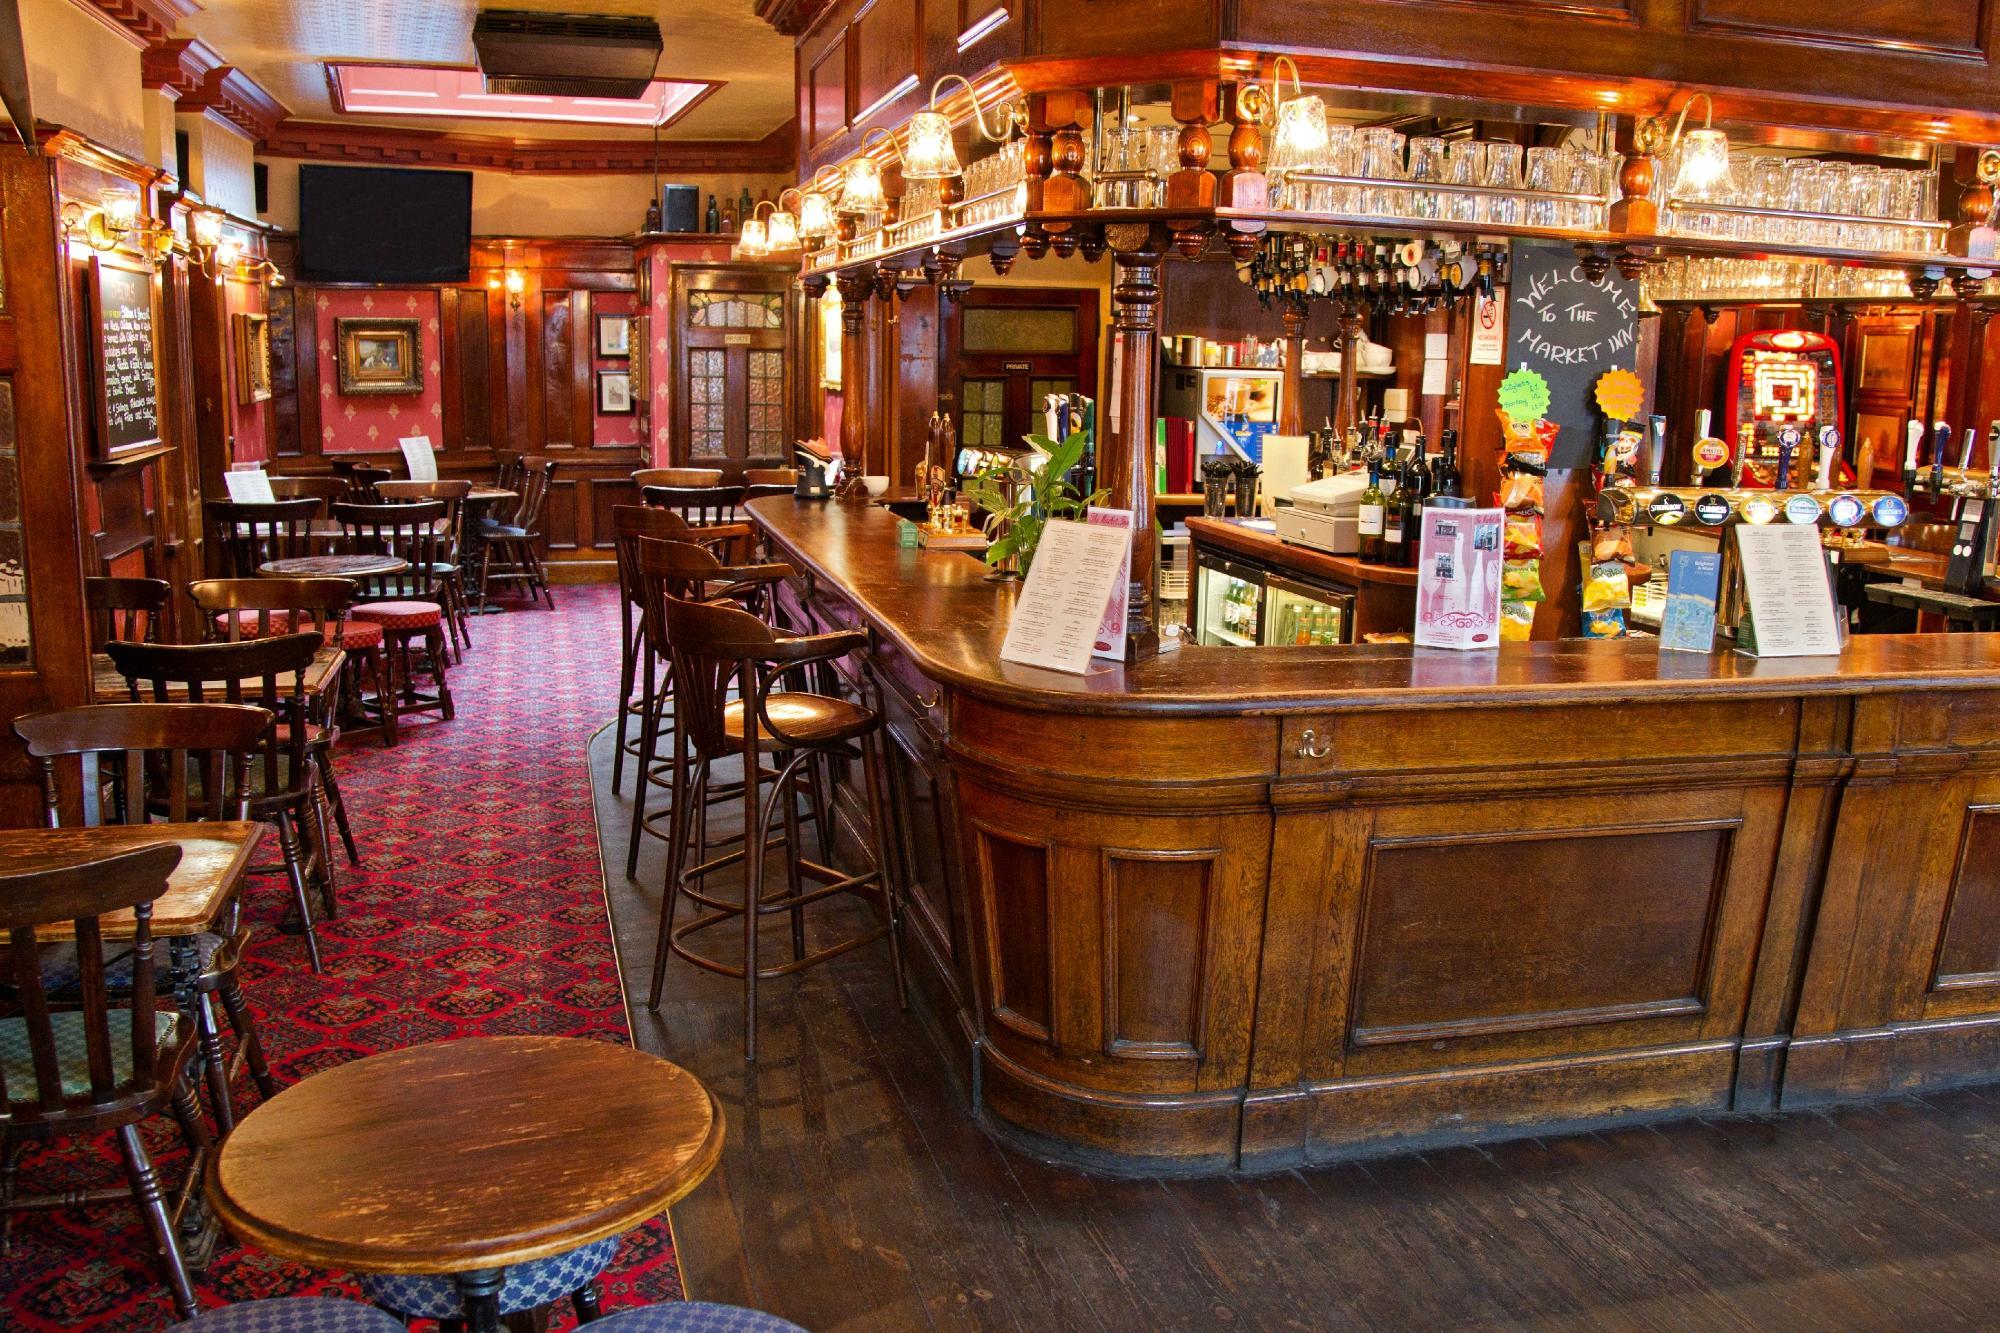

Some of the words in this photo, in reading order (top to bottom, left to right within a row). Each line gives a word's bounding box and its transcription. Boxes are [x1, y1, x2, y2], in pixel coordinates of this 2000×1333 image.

[1537, 303, 1556, 322] TO
[1564, 302, 1598, 322] THE
[1517, 328, 1602, 365] MARKET
[1607, 322, 1634, 354] INN
[1650, 503, 1682, 512] STRONGBOW
[1698, 504, 1728, 513] GUINNESS
